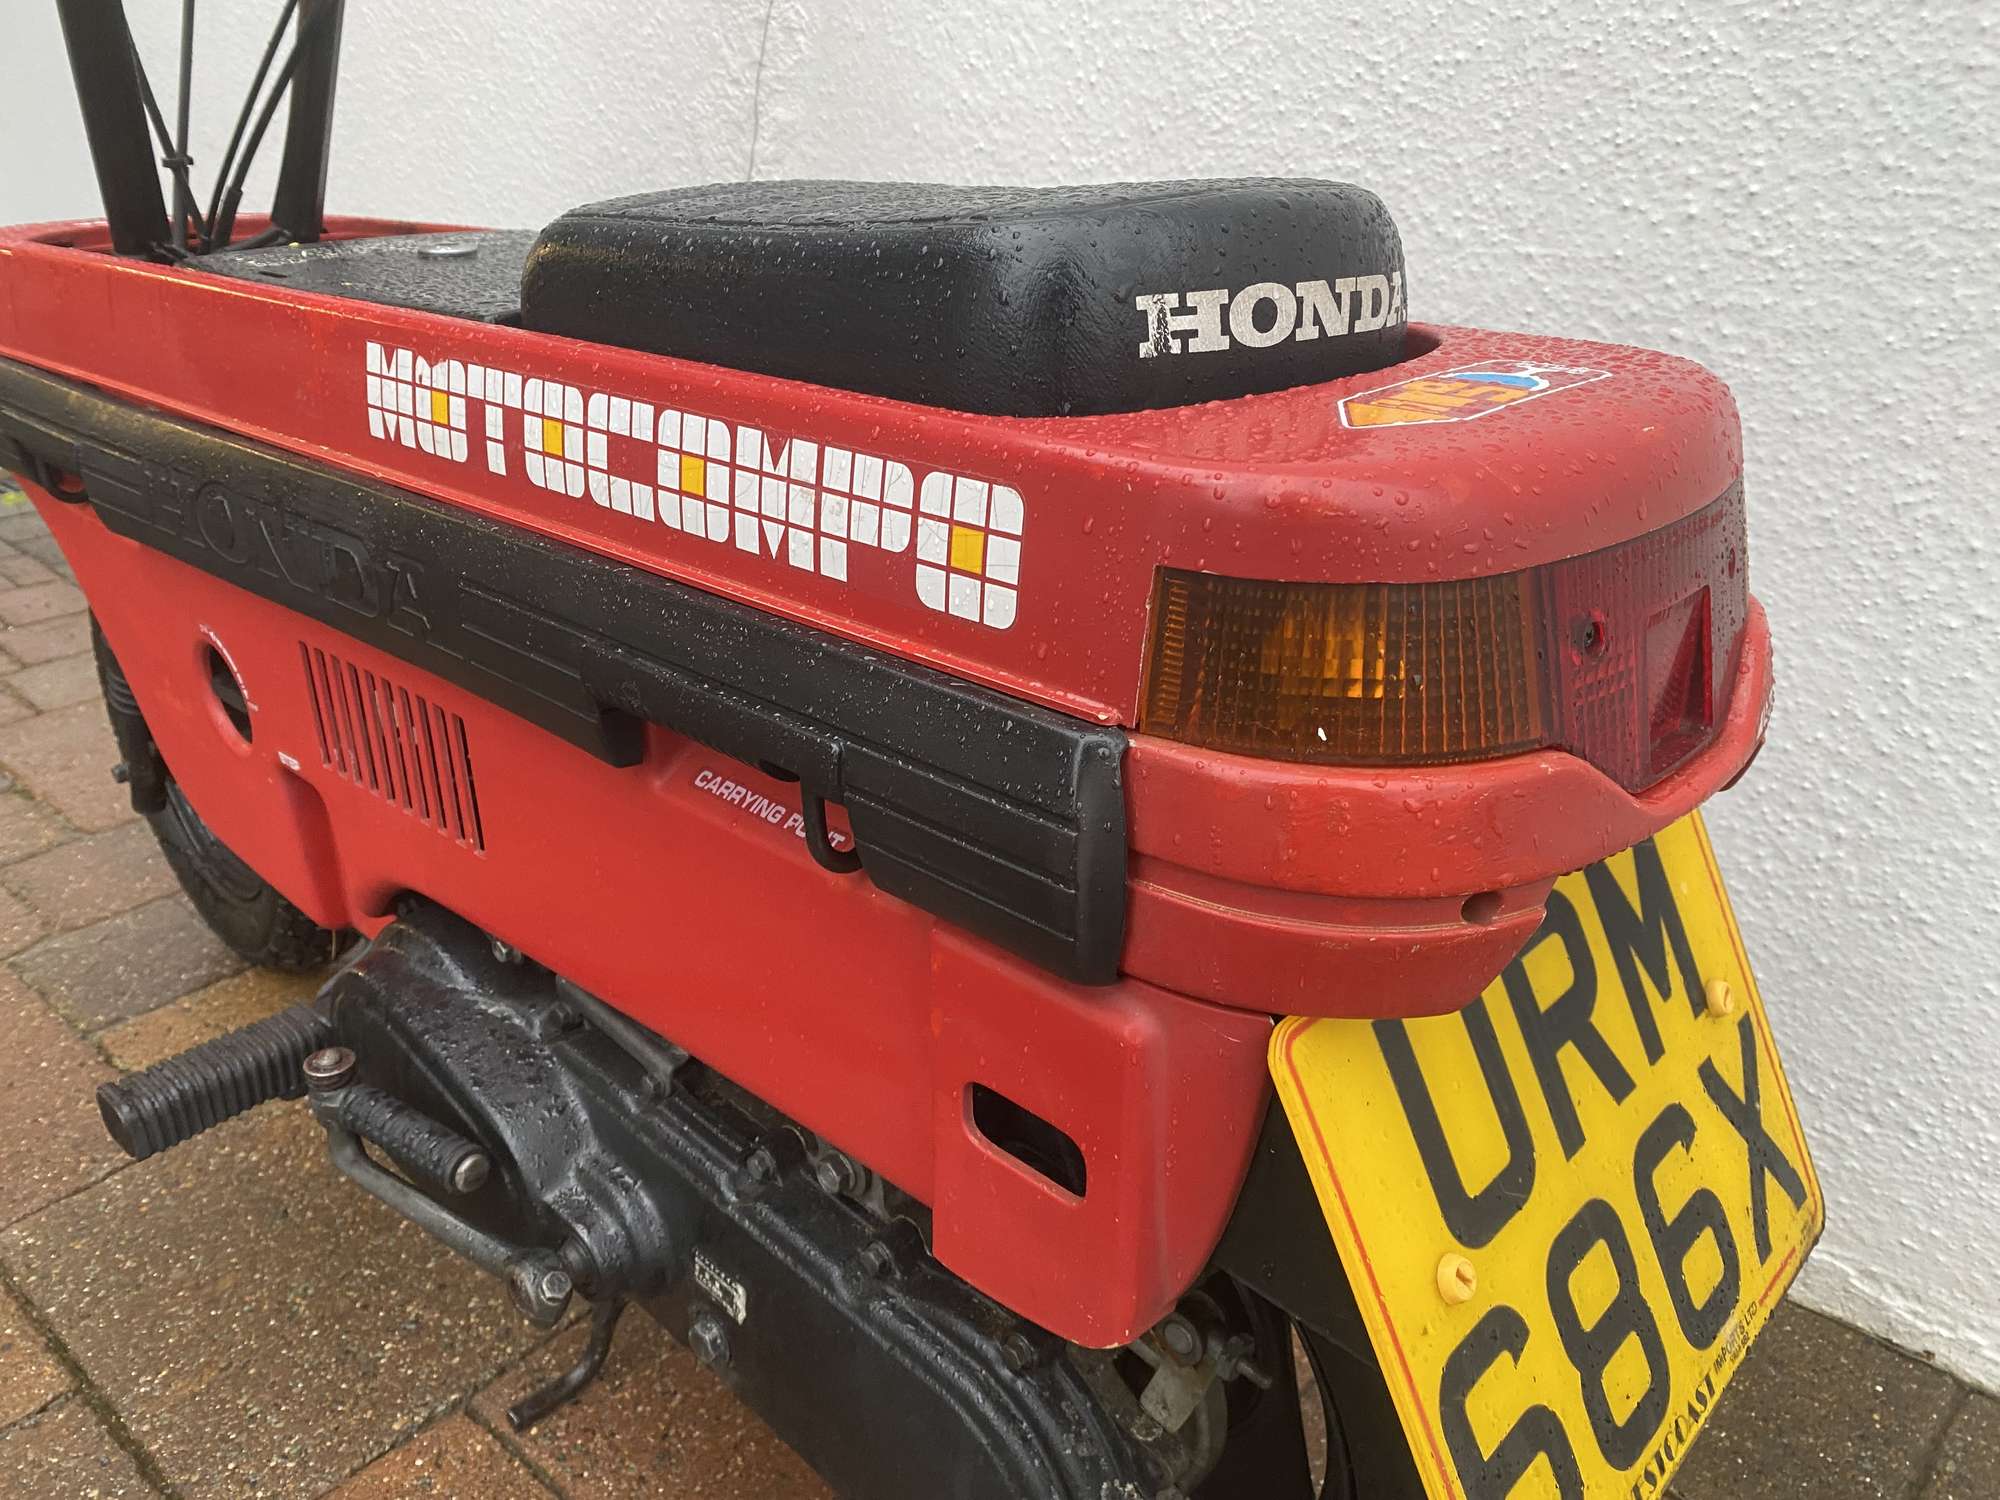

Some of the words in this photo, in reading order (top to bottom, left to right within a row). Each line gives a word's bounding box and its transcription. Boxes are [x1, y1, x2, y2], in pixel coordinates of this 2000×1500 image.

[1136, 271, 1406, 358] HONDA
[144, 457, 431, 637] HONDA
[366, 341, 1024, 629] MOTOCOMPO
[694, 770, 786, 824] CARRYING
[783, 812, 846, 847] POT
[1439, 1012, 1808, 1500] 686X
[1744, 1301, 1758, 1326] LTD
